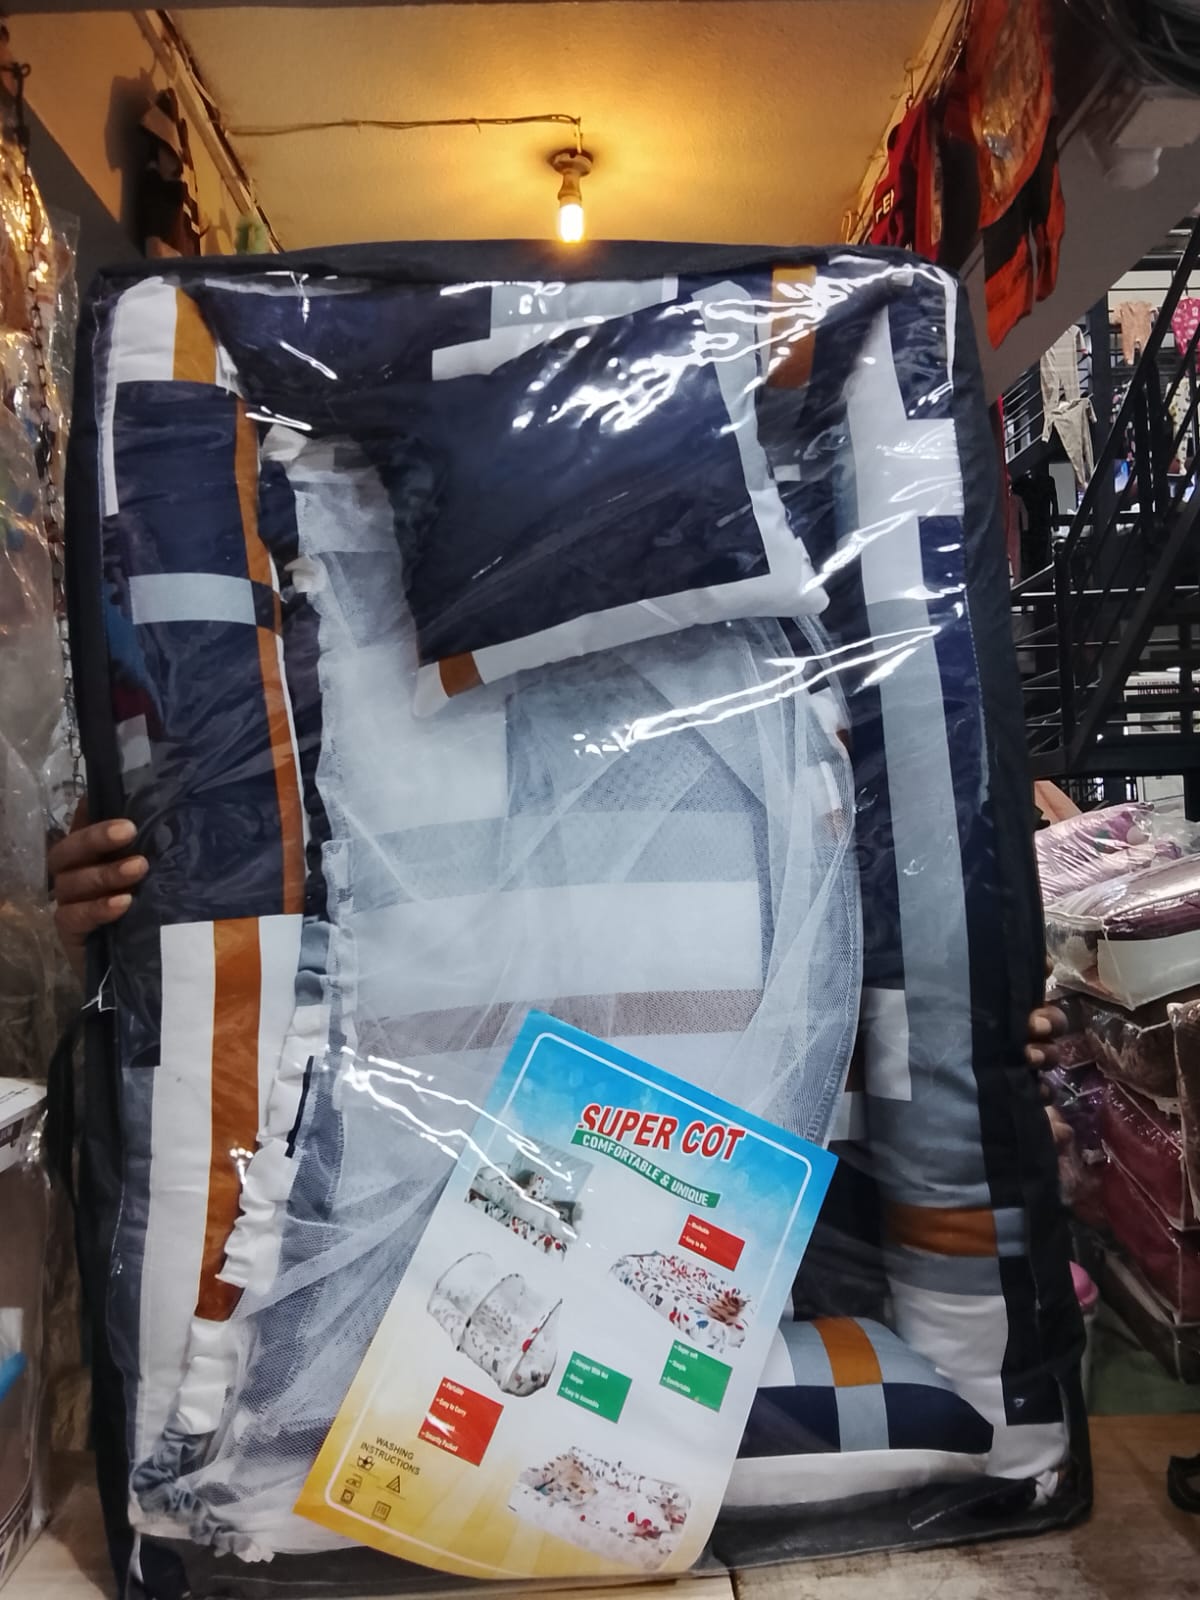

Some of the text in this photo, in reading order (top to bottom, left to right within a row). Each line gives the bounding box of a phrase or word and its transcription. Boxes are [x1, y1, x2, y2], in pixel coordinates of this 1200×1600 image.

[578, 1103, 746, 1162] SUPER COT
[582, 1134, 709, 1206] COMFORTABLE & UNIQUE
[360, 1442, 421, 1476] INSTRUCTIONS
[376, 1436, 415, 1460] WASHING
